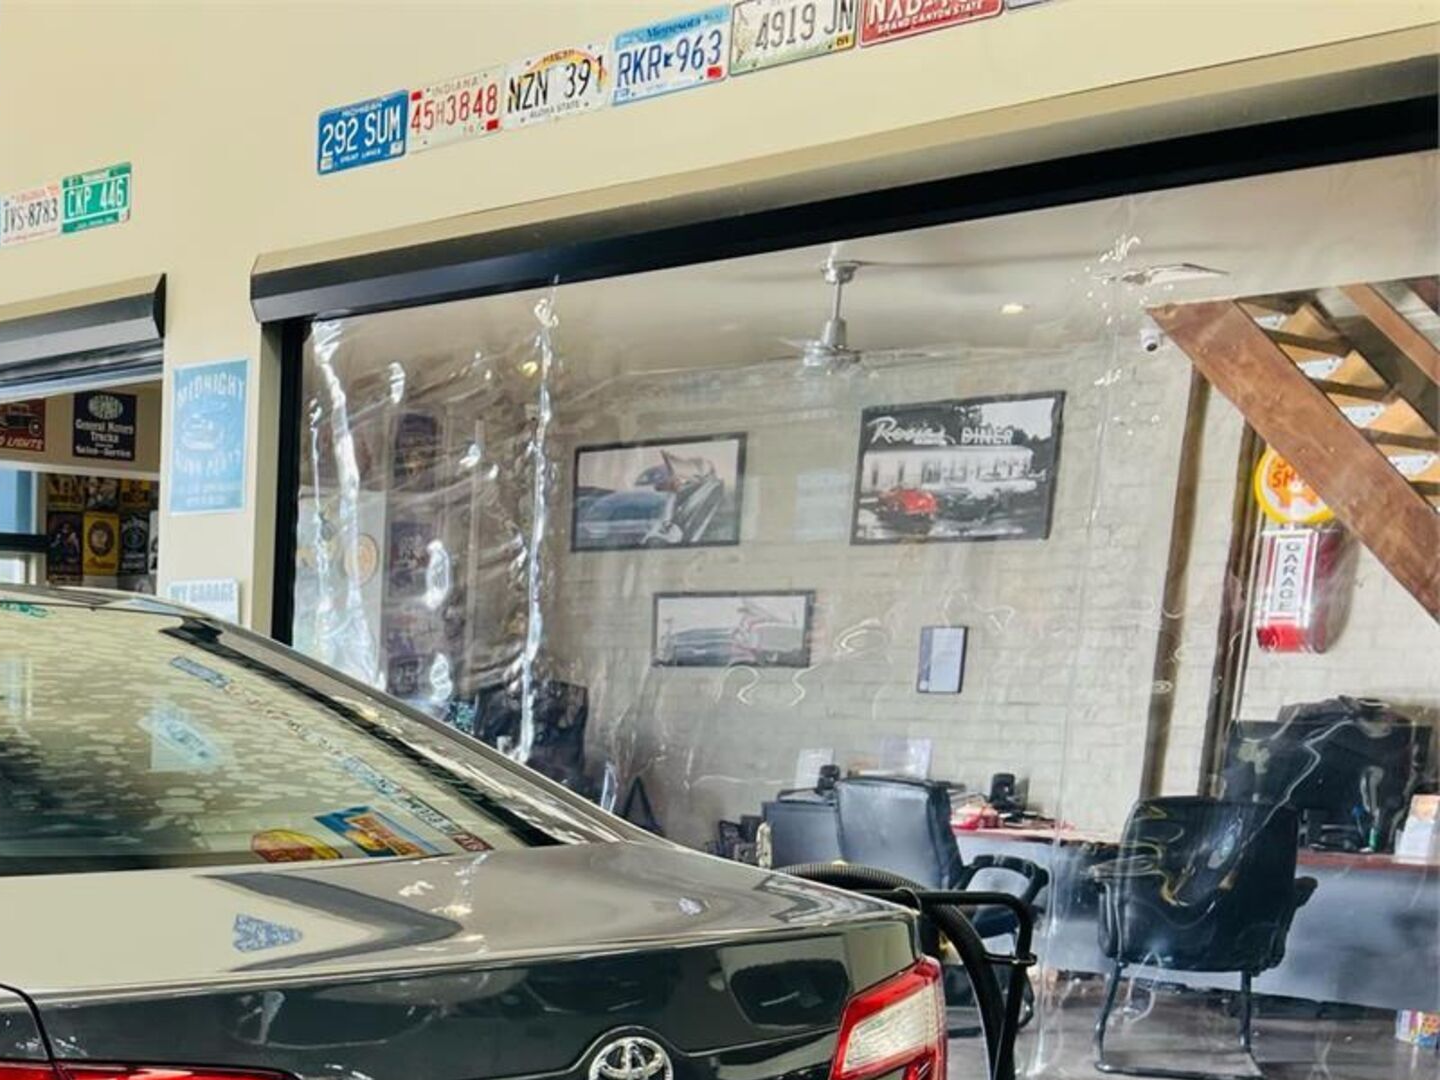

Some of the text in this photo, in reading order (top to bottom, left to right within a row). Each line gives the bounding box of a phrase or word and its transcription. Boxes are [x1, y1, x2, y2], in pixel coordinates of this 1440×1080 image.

[755, 0, 853, 50] 4919 JN
[431, 76, 478, 97] INDIANA
[507, 55, 604, 113] NZN 391
[322, 104, 401, 157] 292 SUM
[177, 372, 245, 408] MIDNIGHT
[7, 435, 44, 450] LIGHTS
[961, 426, 1014, 444] DINER
